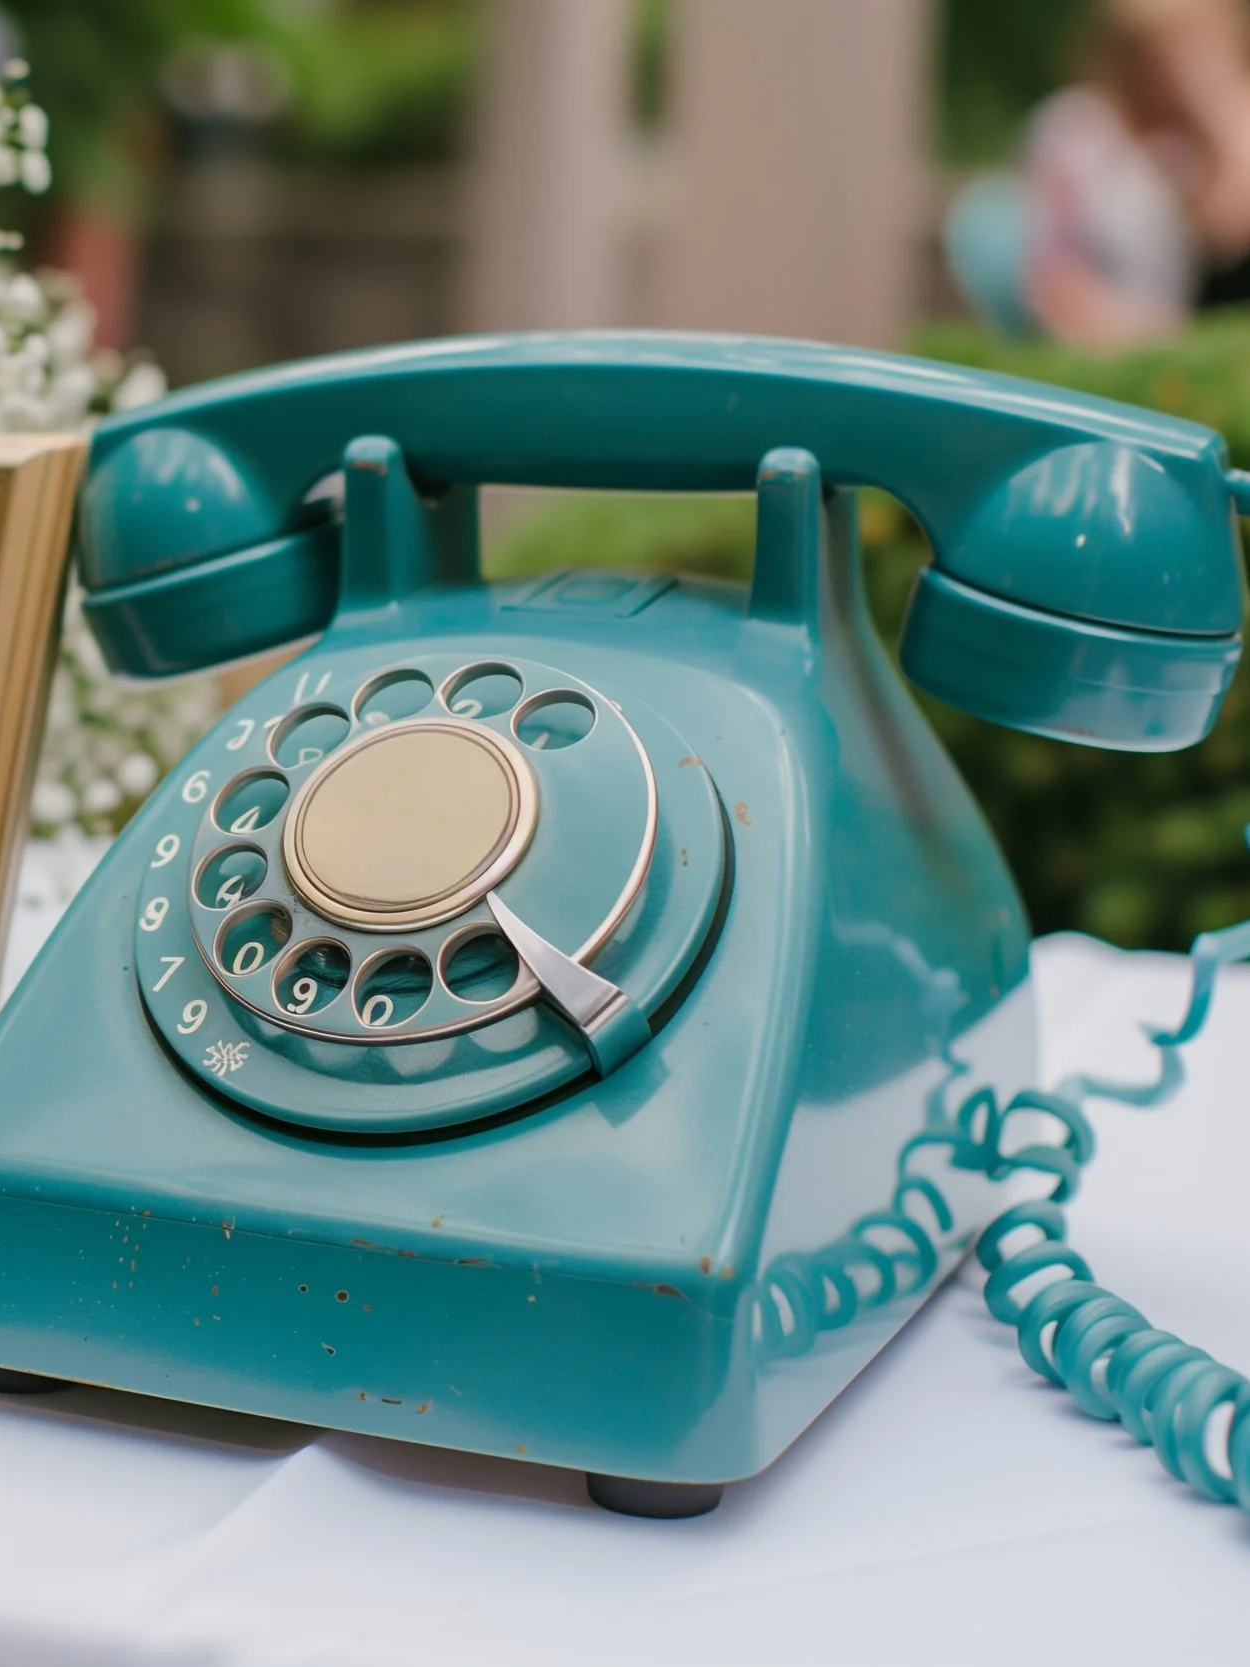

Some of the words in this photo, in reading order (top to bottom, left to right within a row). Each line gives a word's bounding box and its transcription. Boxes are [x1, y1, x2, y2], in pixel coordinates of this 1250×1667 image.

[182, 770, 211, 804] 6
[151, 834, 180, 868] 9
[139, 897, 169, 932] 9
[153, 957, 185, 992] 7
[233, 941, 264, 975] 0
[177, 1000, 208, 1034] 9
